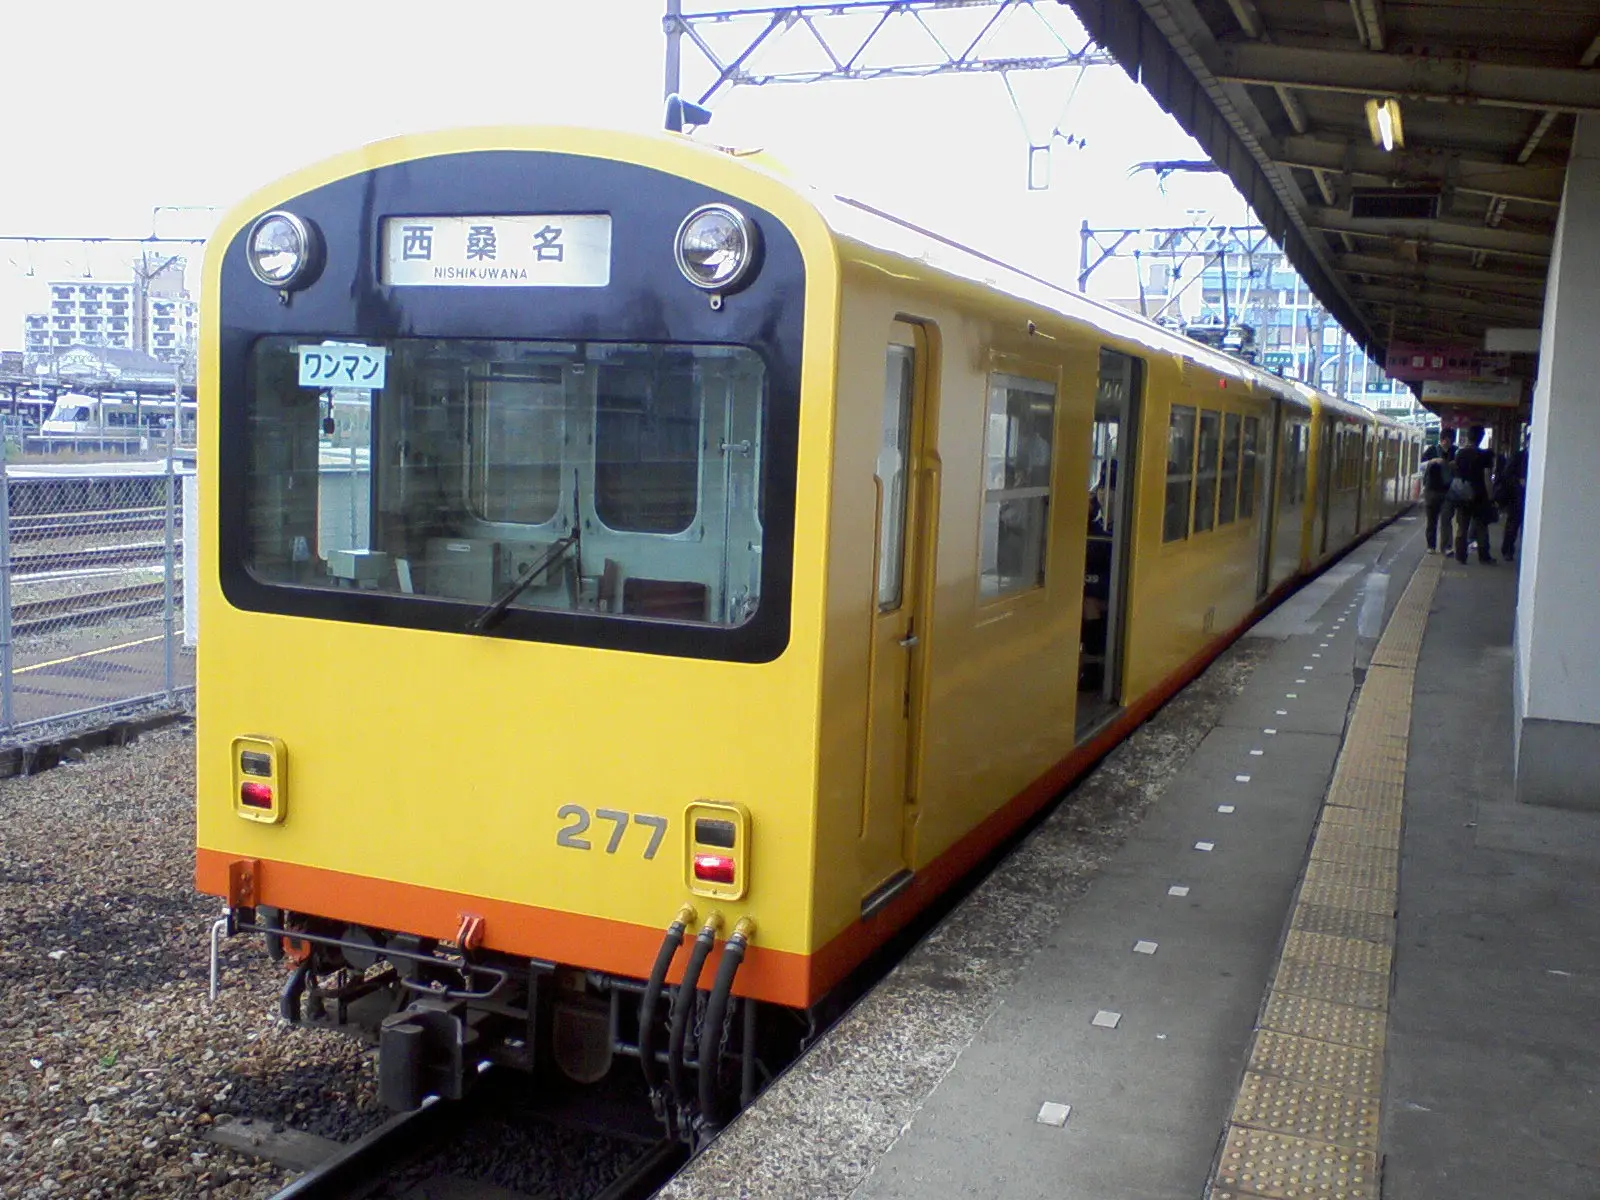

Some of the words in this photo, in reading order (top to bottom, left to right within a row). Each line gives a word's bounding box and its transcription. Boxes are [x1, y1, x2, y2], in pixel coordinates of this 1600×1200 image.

[402, 225, 564, 262] 西桑名
[434, 267, 528, 279] NISHIKUWANA
[305, 354, 379, 381] ワンマン
[556, 804, 668, 860] 277
